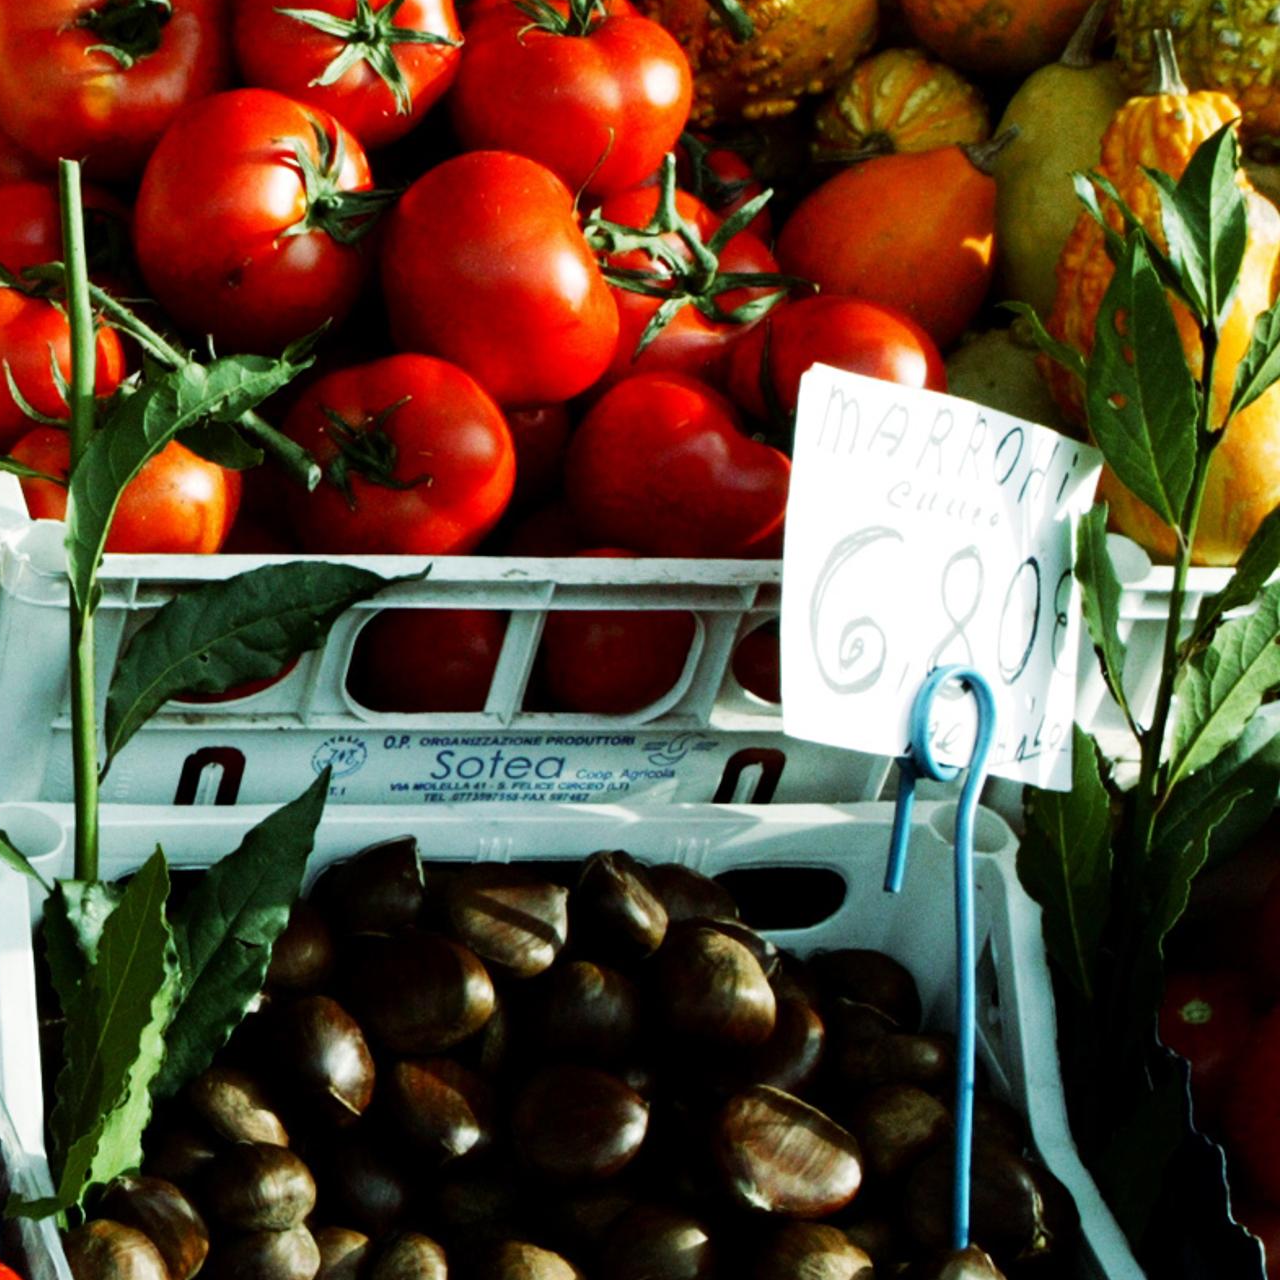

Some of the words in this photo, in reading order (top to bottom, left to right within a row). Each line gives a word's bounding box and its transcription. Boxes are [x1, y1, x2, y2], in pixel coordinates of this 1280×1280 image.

[419, 735, 544, 747] ORGANIZZAZIONE
[545, 735, 636, 747] PRODUTTORI
[430, 749, 566, 780] Sotea
[620, 769, 676, 781] Agricola
[511, 782, 556, 791] FELICE
[557, 782, 604, 791] CIRCEO
